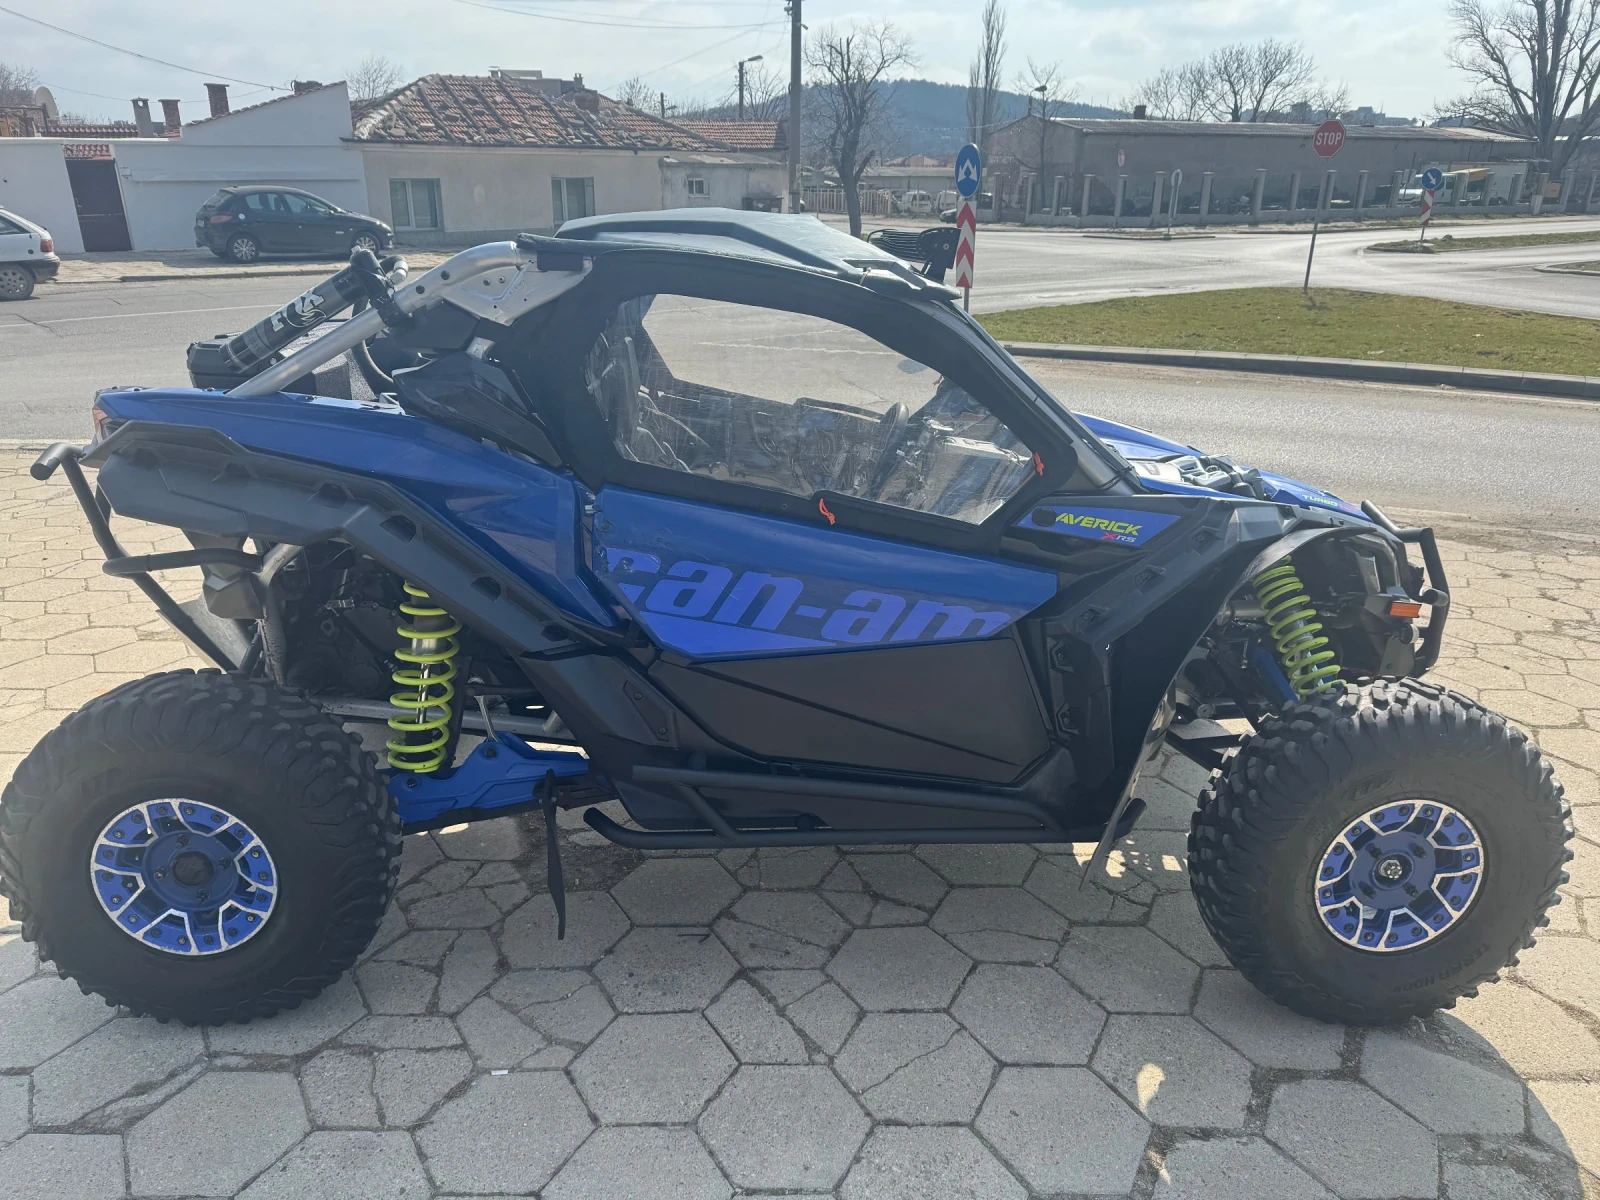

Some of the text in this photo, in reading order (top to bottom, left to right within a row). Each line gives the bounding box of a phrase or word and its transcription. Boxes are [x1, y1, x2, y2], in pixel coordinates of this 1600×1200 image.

[1315, 132, 1342, 146] STOP
[270, 287, 327, 333] FOX
[1302, 494, 1338, 507] TURBO
[1055, 512, 1143, 536] AVERICK
